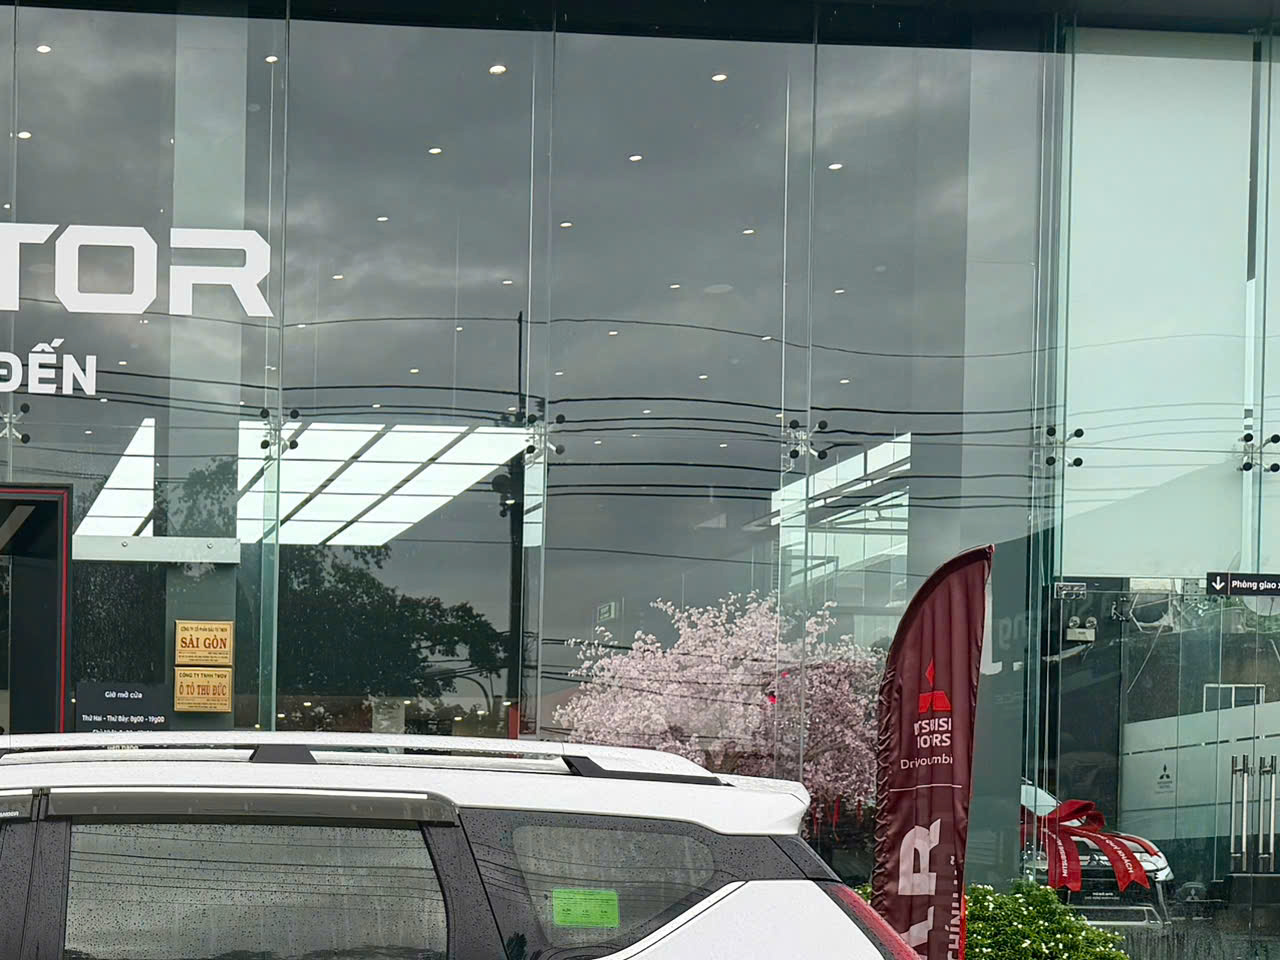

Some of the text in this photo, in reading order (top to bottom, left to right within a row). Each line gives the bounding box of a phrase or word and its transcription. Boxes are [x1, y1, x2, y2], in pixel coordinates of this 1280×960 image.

[1231, 580, 1258, 590] Phòng
[1258, 581, 1277, 590] giao
[180, 634, 228, 649] SÀI GÒN
[179, 681, 185, 696] Ô
[186, 681, 195, 696] TÔ
[197, 680, 211, 696] THỦ
